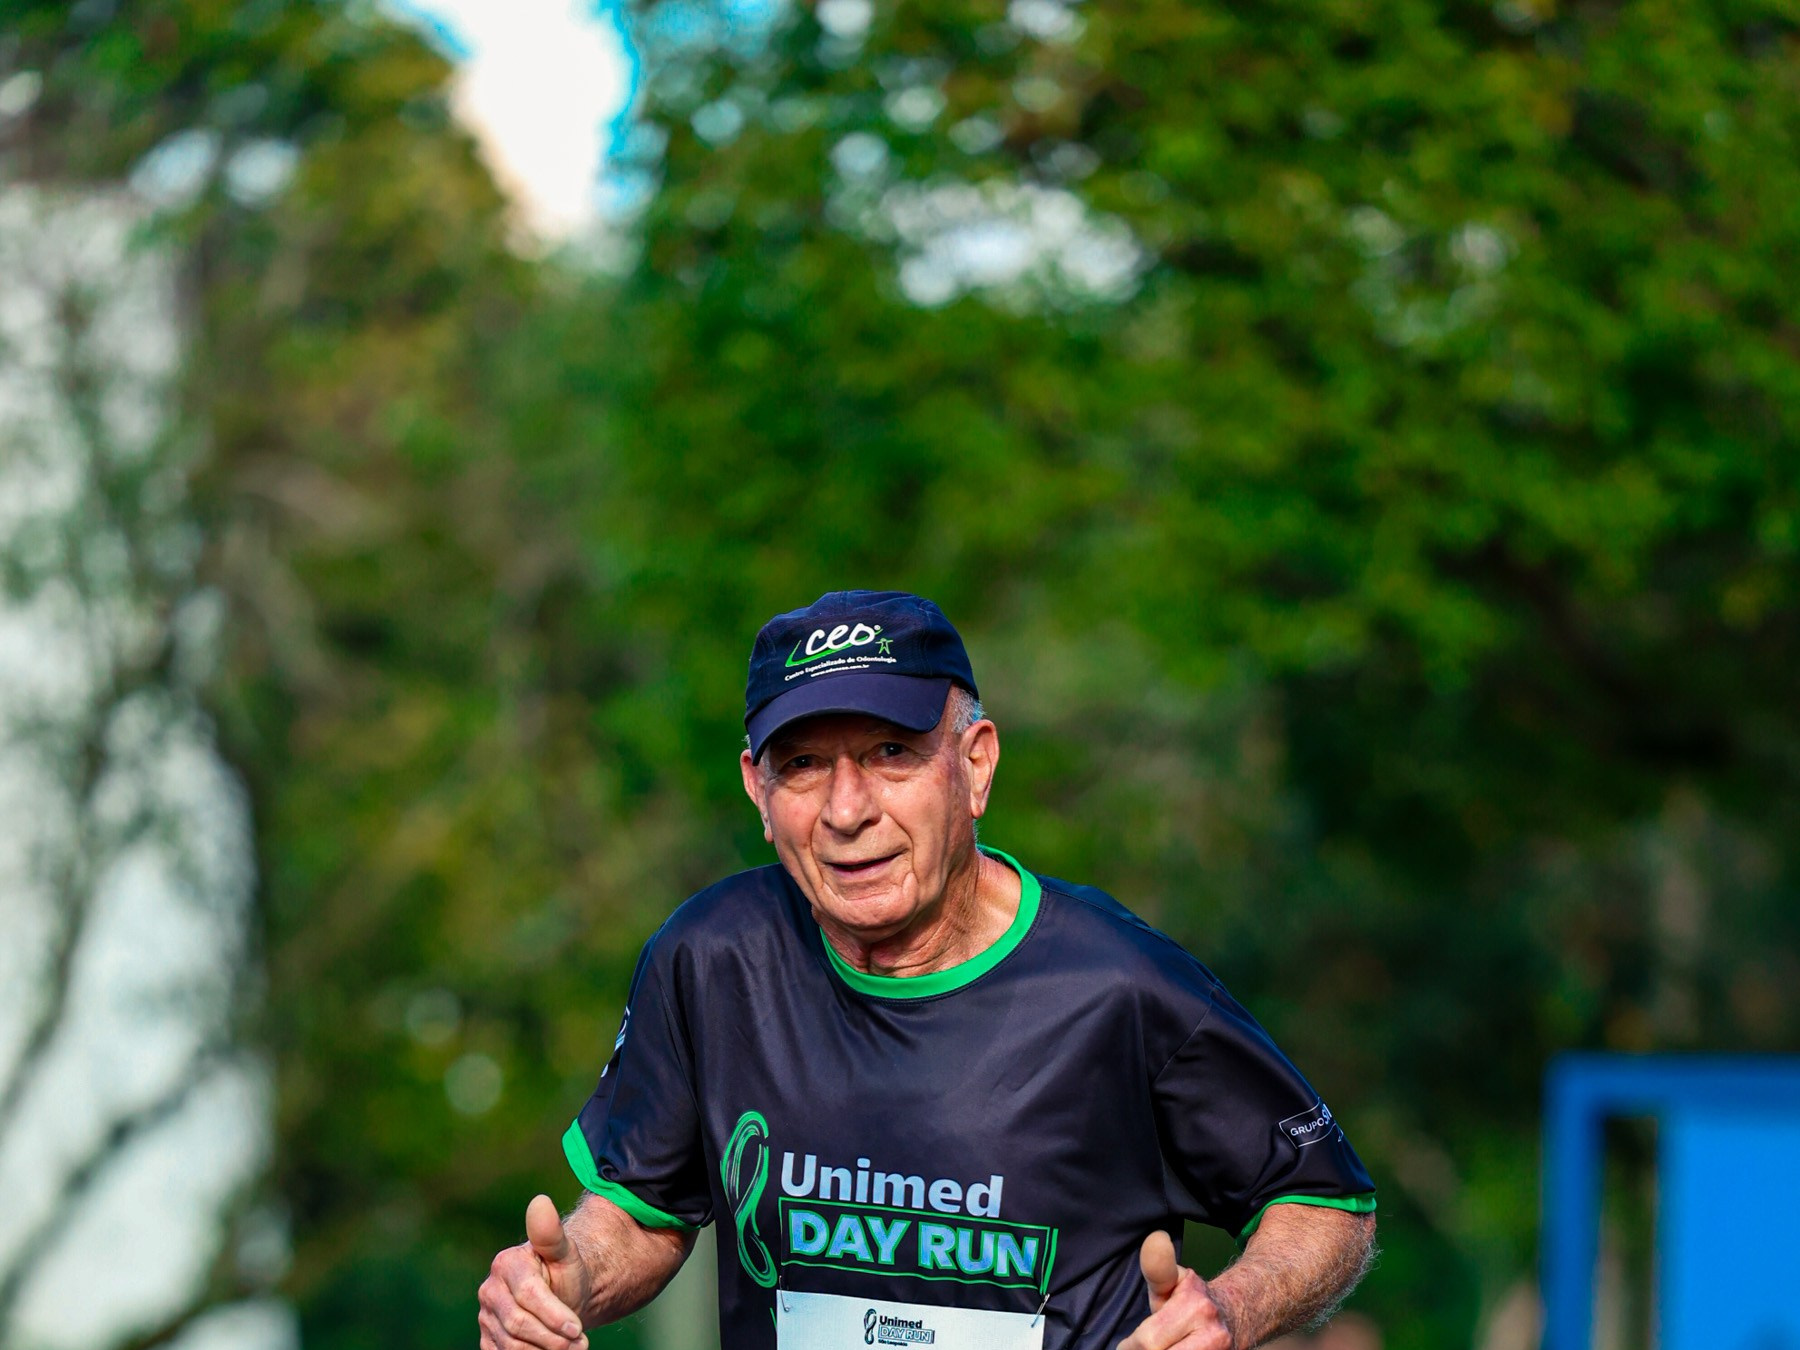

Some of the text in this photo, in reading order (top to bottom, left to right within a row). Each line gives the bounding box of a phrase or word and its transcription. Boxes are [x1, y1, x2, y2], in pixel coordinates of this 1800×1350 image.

[1290, 1117, 1324, 1136] GRUPO
[780, 1151, 1004, 1218] Unimed
[788, 1208, 1040, 1278] DAY RUN
[880, 1315, 923, 1329] Unimed
[880, 1325, 905, 1339] DAY
[906, 1329, 931, 1343] RUN
